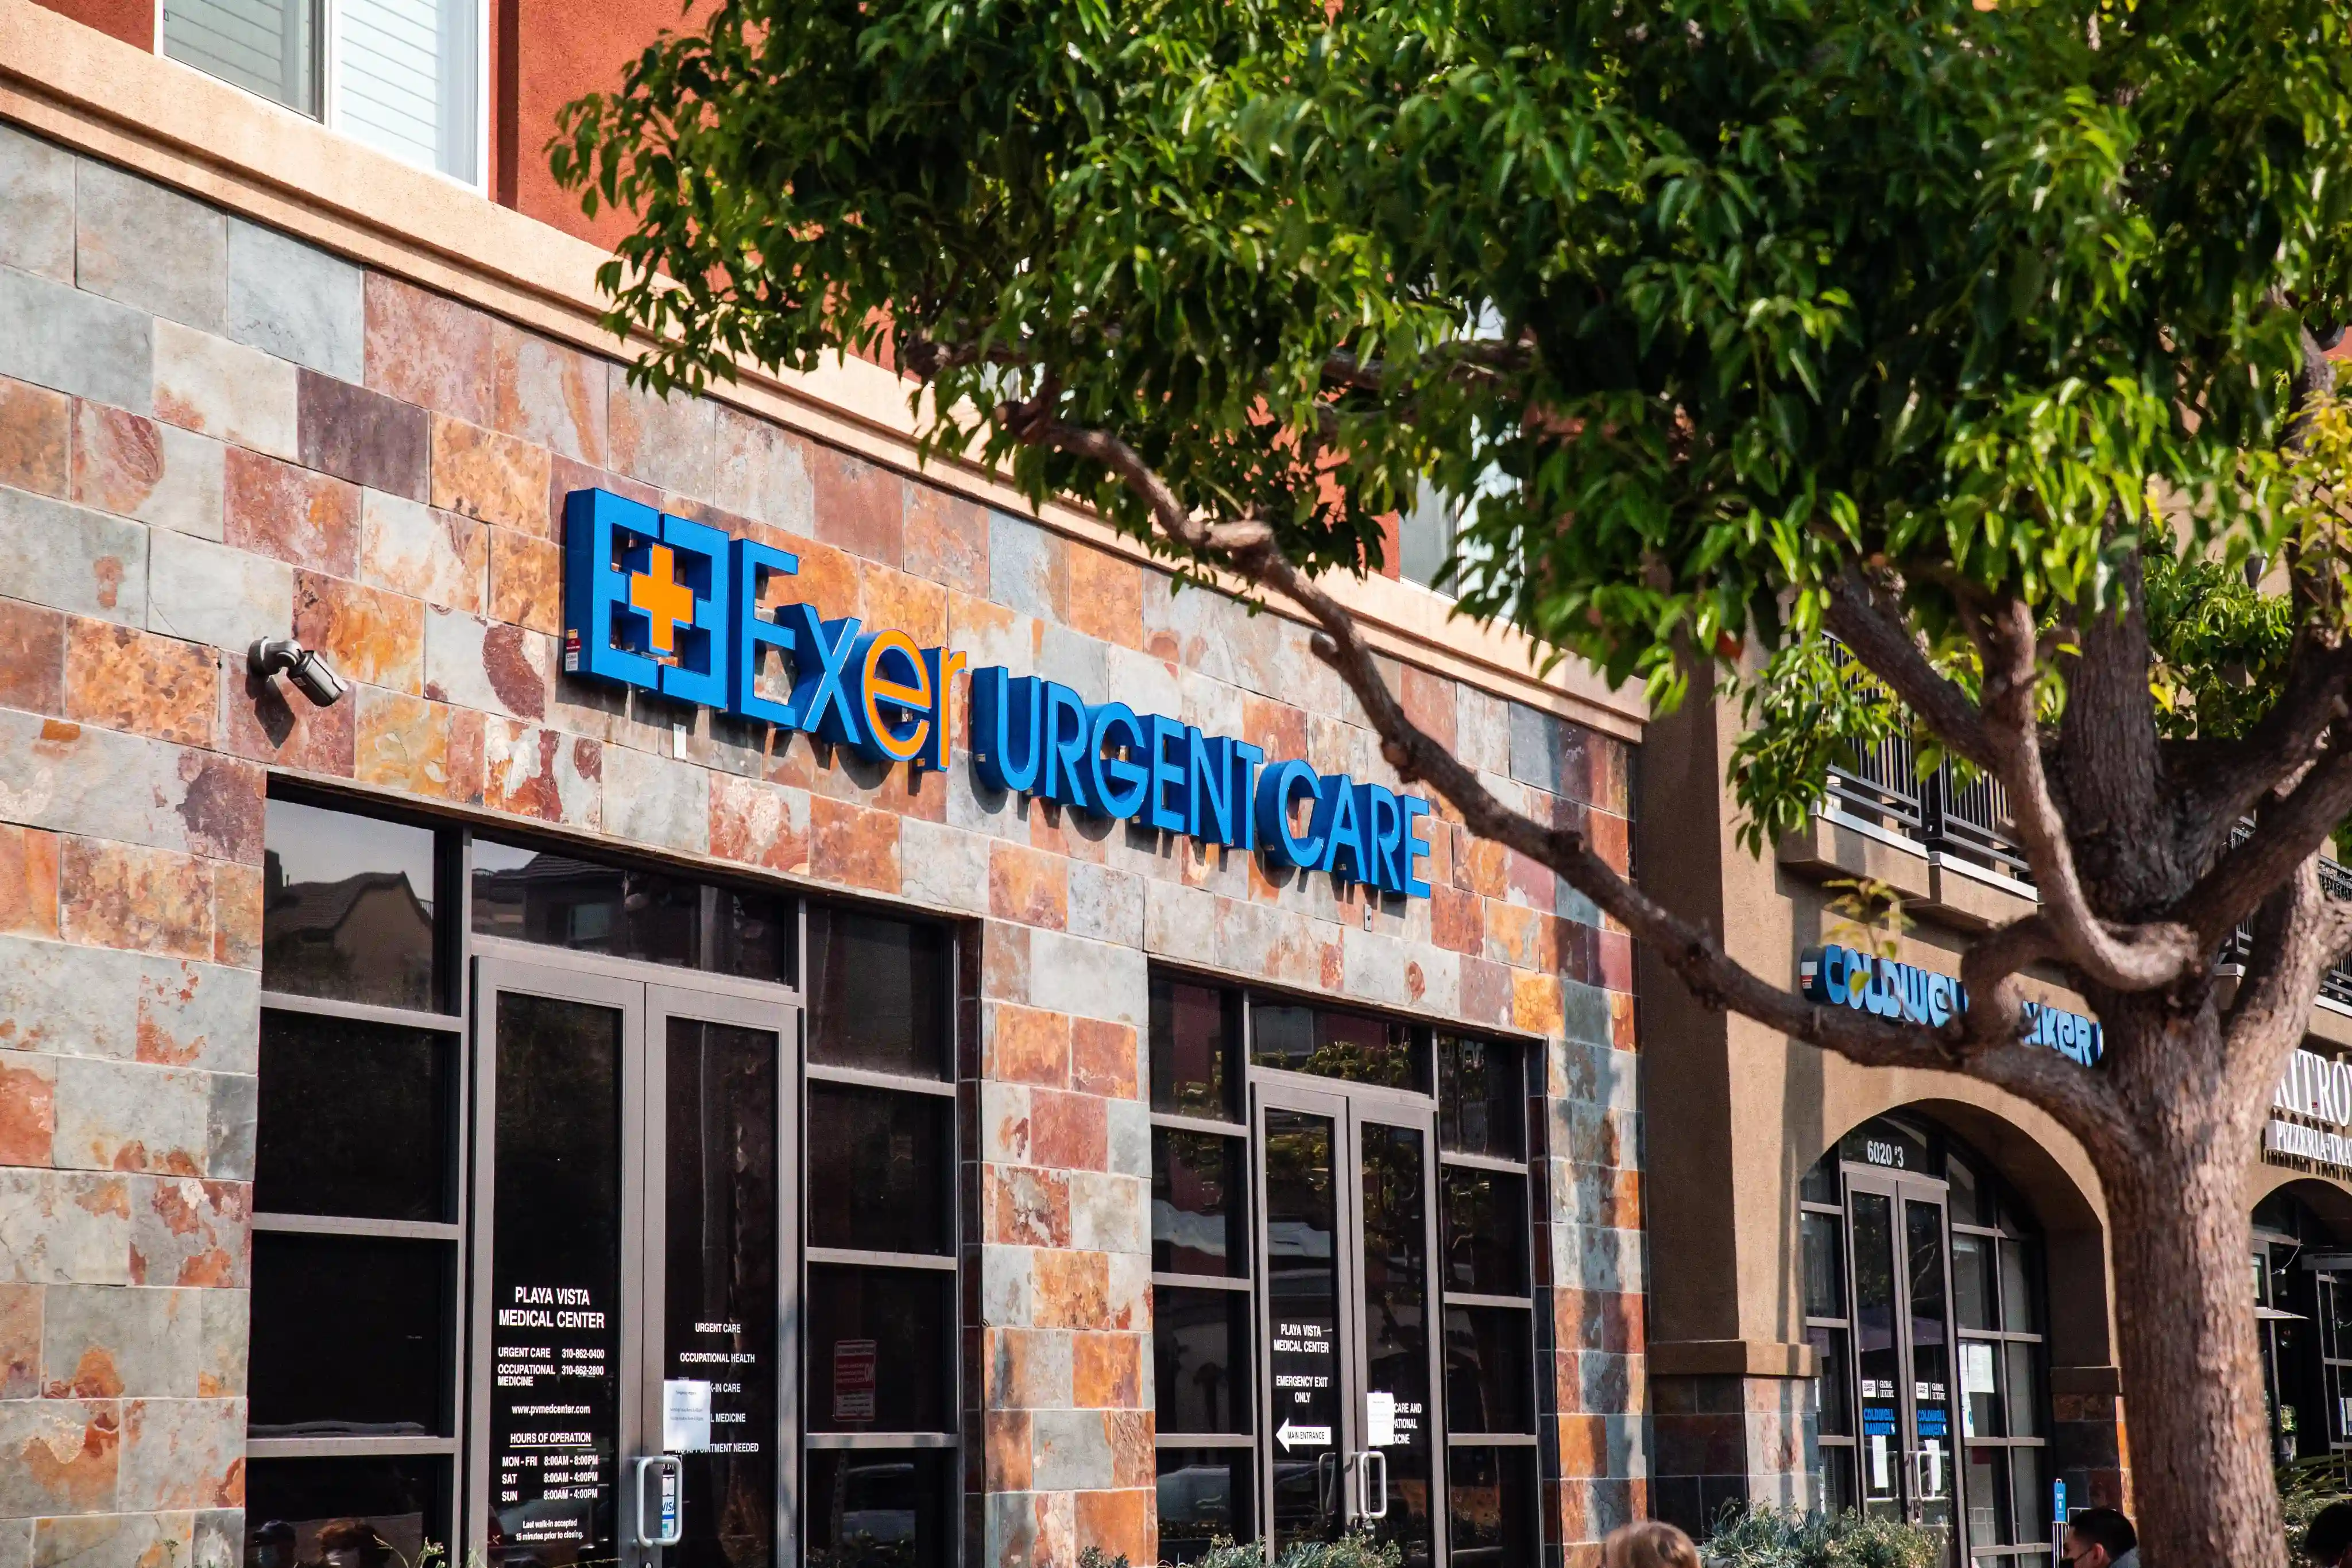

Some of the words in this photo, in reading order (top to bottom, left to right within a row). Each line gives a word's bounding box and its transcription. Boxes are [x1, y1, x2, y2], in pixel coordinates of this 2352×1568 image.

[730, 538, 967, 772] Exer
[973, 665, 1263, 852] URGENT
[1258, 758, 1431, 900] CARE
[1824, 944, 1970, 1028] COLDWE
[1867, 1140, 1892, 1166] 6020
[515, 1286, 554, 1304] PLAYA
[556, 1288, 590, 1306] VISTA
[499, 1309, 554, 1327] MEDICAL
[557, 1311, 605, 1329] CENTER
[695, 1322, 722, 1333] URGENT
[723, 1323, 741, 1334] CARE
[1281, 1323, 1301, 1337] PLAYA
[1302, 1325, 1321, 1337] VISTA
[1274, 1339, 1302, 1352] MEDICAL
[1303, 1341, 1329, 1353] CENTER
[498, 1346, 529, 1358] URGENT
[530, 1348, 551, 1358] CARE
[562, 1349, 605, 1359] 310-862-0400
[680, 1352, 729, 1363] OCCUPATIONAL
[730, 1353, 755, 1364] HEALTH
[498, 1364, 556, 1375] OCCUPATIONAL
[562, 1365, 604, 1376] 310-862-2800
[497, 1376, 533, 1387] MEDICINE
[1276, 1375, 1313, 1387] EMERGENCY
[1314, 1376, 1328, 1388] EXIT
[723, 1383, 741, 1393] CARE
[1294, 1391, 1311, 1403] ONLY
[512, 1404, 591, 1416] www.pvmedcenter.com
[1394, 1403, 1409, 1414] CARE
[1410, 1403, 1422, 1414] AND
[715, 1412, 746, 1423] MEDICINE
[1394, 1418, 1418, 1429] ATIONAL
[510, 1433, 536, 1443] HOURS
[537, 1433, 548, 1443] OF
[550, 1432, 591, 1443] OPERATION
[1287, 1431, 1299, 1440] MAIN
[1300, 1431, 1325, 1440] ENTRANCE
[1393, 1433, 1410, 1445] DICINE
[733, 1443, 759, 1453] NEEDED
[502, 1456, 520, 1467] MON
[525, 1455, 538, 1466] FRI
[544, 1455, 568, 1466] 8:00AM
[574, 1454, 598, 1465] 8:00PM
[502, 1474, 517, 1485] SAT
[544, 1472, 568, 1483] 8:00AM
[574, 1472, 598, 1482] 4:00PM
[502, 1490, 517, 1501] SUN
[543, 1489, 568, 1500] 8:00AM
[574, 1488, 598, 1499] 4:00PM
[523, 1520, 534, 1528] Last
[535, 1519, 553, 1528] walk-in
[554, 1519, 577, 1528] accepted
[516, 1532, 521, 1541] 15
[523, 1532, 543, 1540] minutes
[544, 1531, 556, 1541] prior
